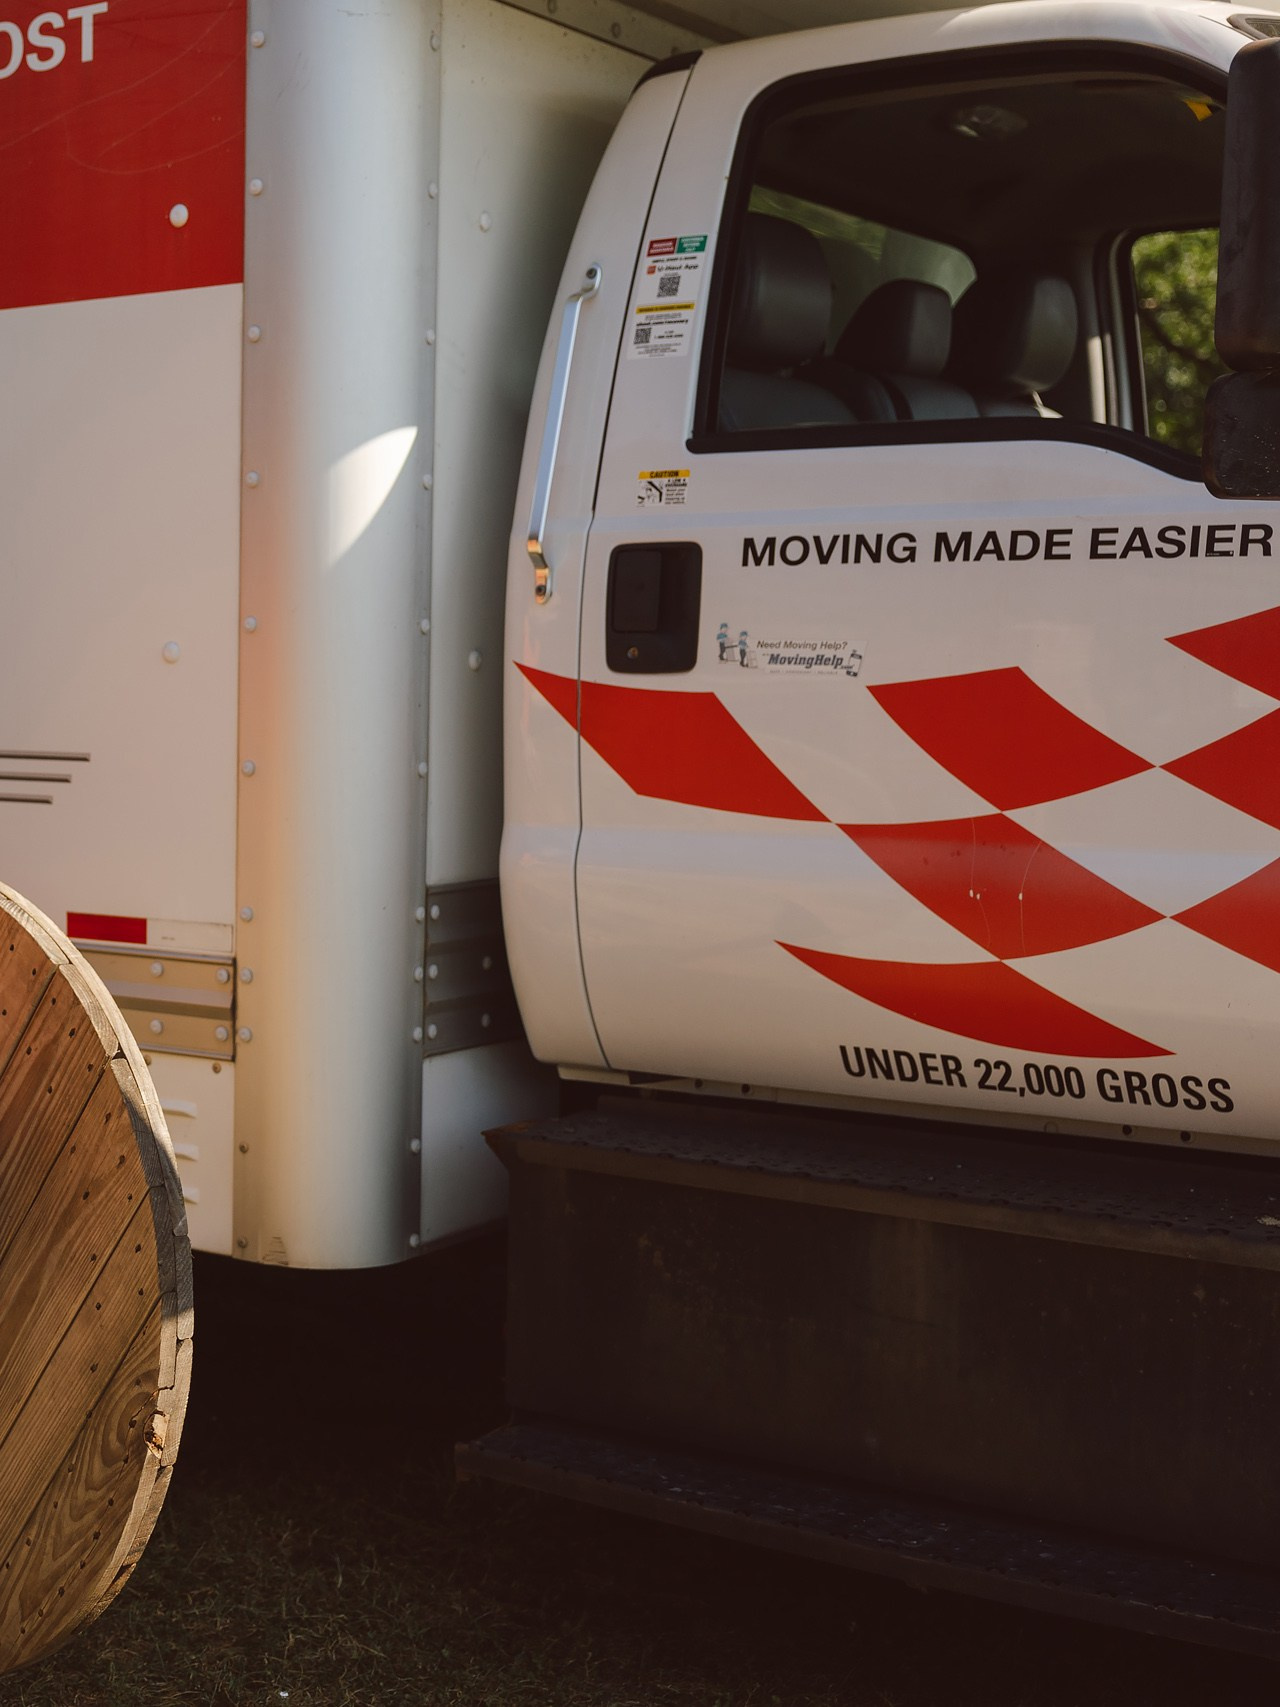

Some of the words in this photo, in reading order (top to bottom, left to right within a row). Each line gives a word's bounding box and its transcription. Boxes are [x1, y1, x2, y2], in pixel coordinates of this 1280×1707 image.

[741, 532, 917, 567] MOVING
[933, 528, 1073, 563] MADE
[1089, 523, 1274, 560] EASIER
[756, 640, 781, 649] Need
[783, 641, 818, 651] Moving
[820, 641, 848, 651] Help?
[839, 1044, 968, 1089] UNDER
[973, 1058, 1086, 1100] 22,000
[1096, 1068, 1235, 1114] GROSS
